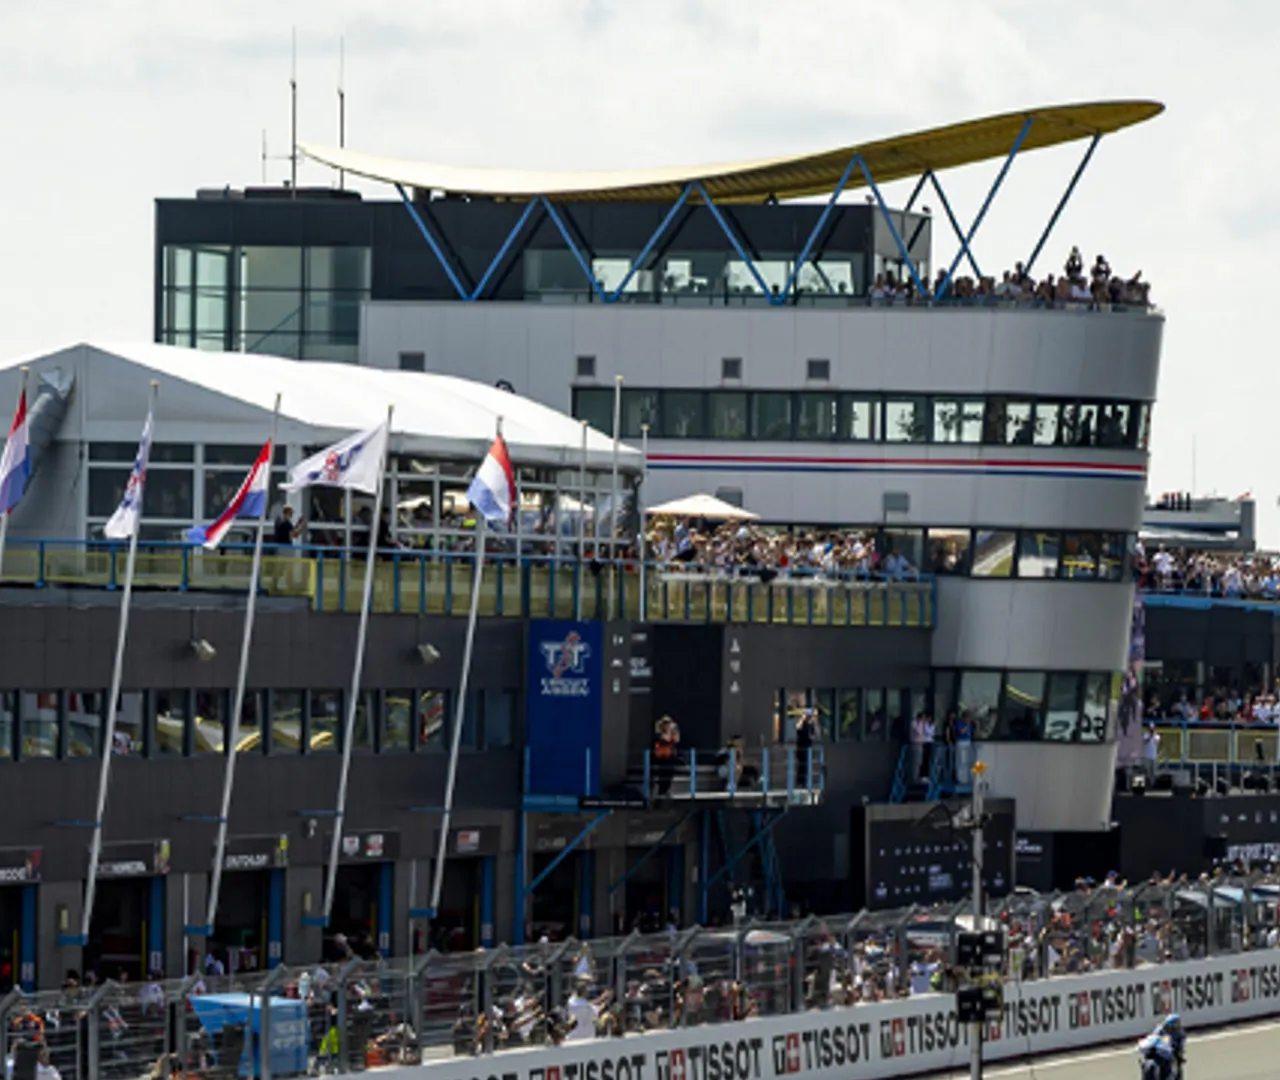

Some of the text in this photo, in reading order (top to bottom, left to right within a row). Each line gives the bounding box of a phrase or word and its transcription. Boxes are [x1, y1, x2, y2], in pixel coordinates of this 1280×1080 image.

[1090, 983, 1146, 1024] TISSOT
[1170, 972, 1225, 1012] TISSOT
[803, 1023, 872, 1070] TISSOT
